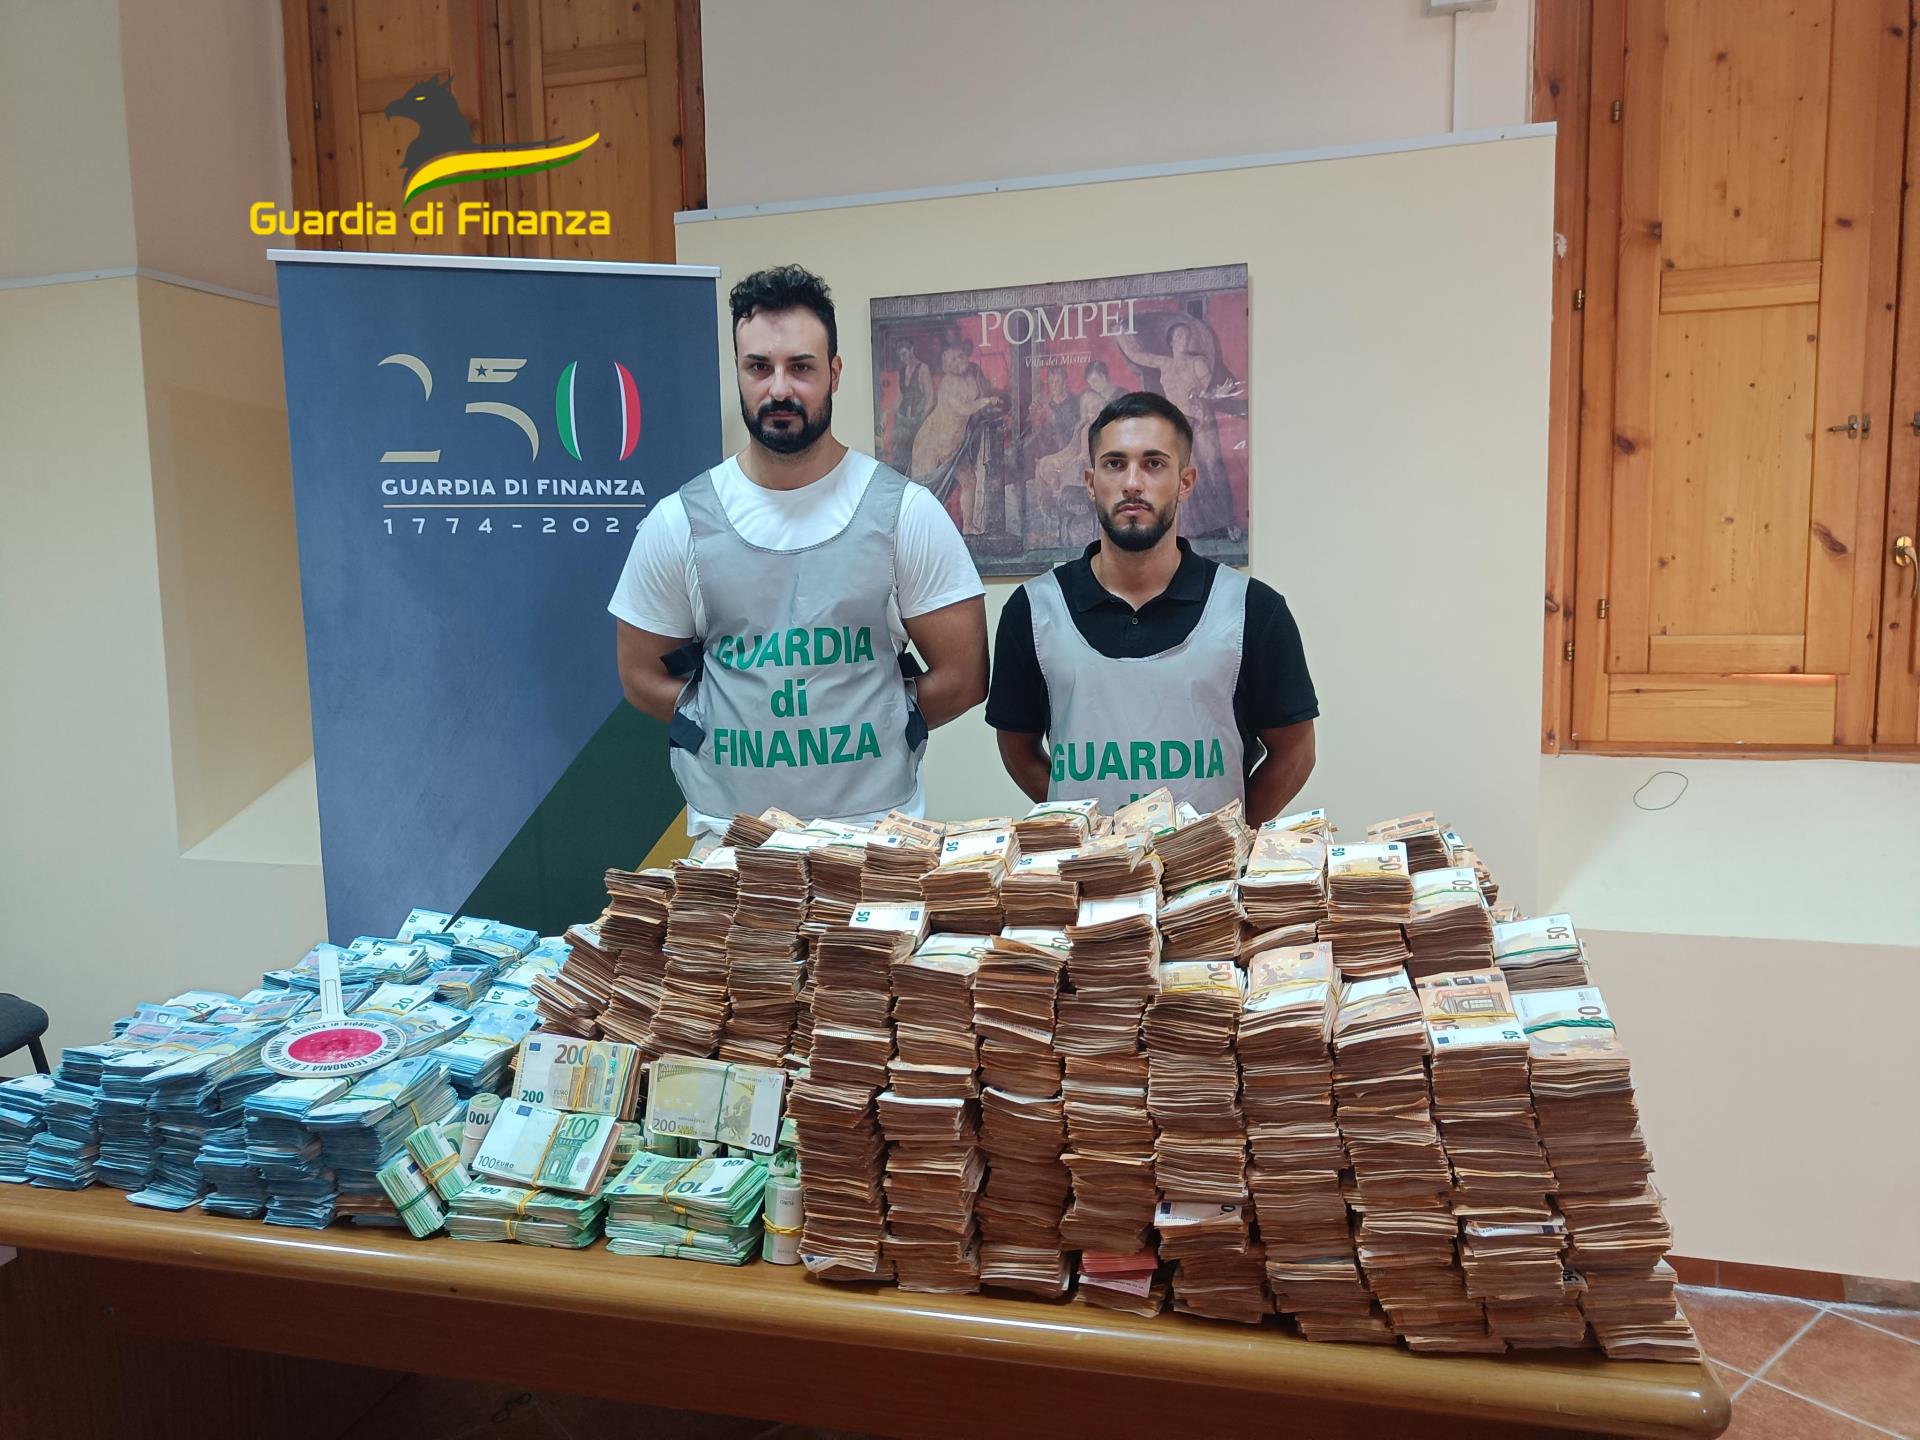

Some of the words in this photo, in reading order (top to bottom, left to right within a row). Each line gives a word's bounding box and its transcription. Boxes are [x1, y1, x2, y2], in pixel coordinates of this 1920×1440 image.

[977, 299, 1139, 347] POMPEI
[1061, 353, 1091, 365] Misteri
[381, 479, 496, 496] GUARDIA
[504, 479, 528, 496] DI
[537, 479, 646, 496] FINANZA
[716, 626, 875, 670] GUARDIA
[770, 679, 808, 718] di
[714, 722, 882, 768] FINANZA
[1052, 738, 1225, 782] GUARDIA
[945, 841, 959, 852] 50
[1331, 847, 1345, 857] 50
[1378, 855, 1402, 871] 50
[855, 911, 871, 923] 50
[1546, 926, 1570, 940] 50
[373, 946, 387, 956] 20
[491, 990, 504, 1000] 20
[392, 997, 414, 1010] 20
[1502, 1030, 1521, 1040] 50
[312, 1058, 370, 1072] ECONOMIA
[521, 1090, 544, 1103] 200
[468, 1111, 490, 1125] 100
[566, 1117, 600, 1140] 100
[652, 1118, 677, 1133] 200
[750, 1133, 771, 1148] 200
[478, 1155, 496, 1169] 100
[723, 1159, 745, 1168] 100
[478, 1186, 502, 1195] 100
